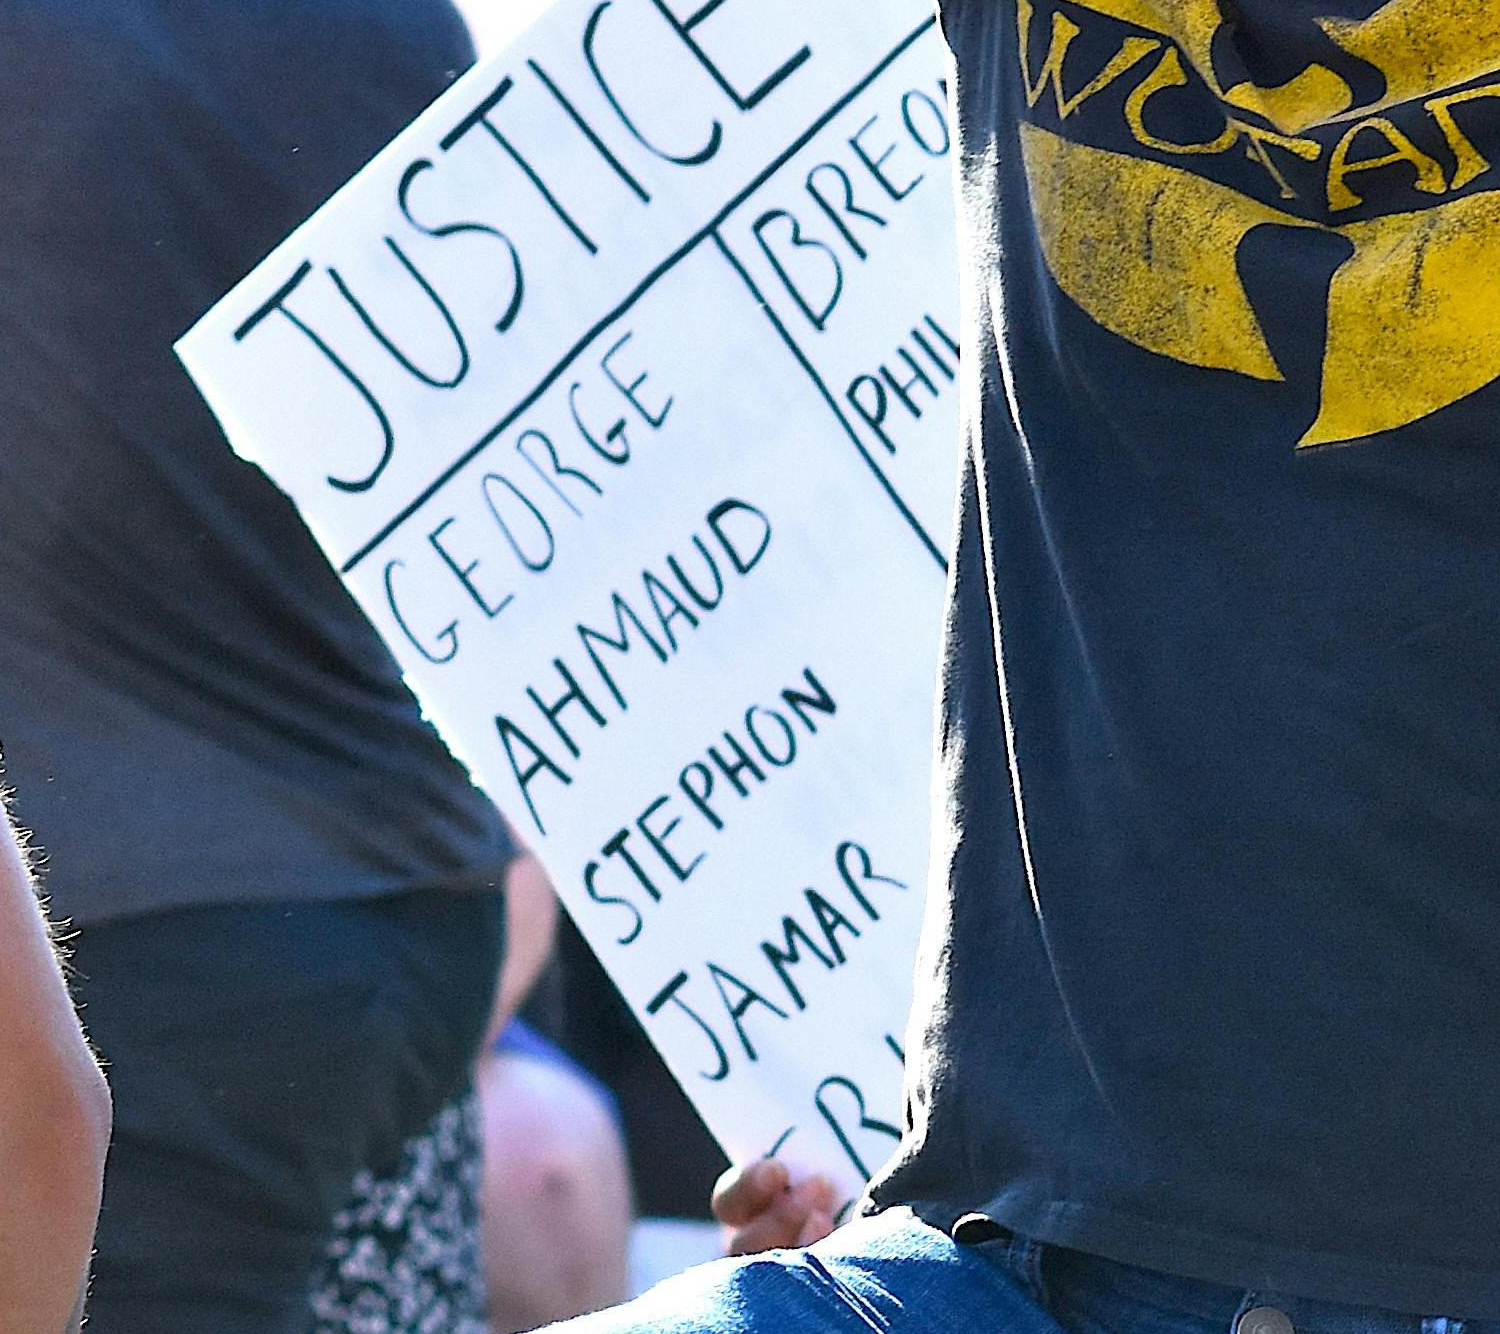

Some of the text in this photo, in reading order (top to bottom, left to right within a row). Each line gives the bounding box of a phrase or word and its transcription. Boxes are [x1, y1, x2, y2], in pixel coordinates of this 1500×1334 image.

[751, 78, 952, 332] BREO
[382, 329, 676, 665] GEORGE
[493, 497, 773, 835] AHMAUD
[581, 666, 838, 946] STEPHON
[646, 839, 909, 1082] JAMAR
